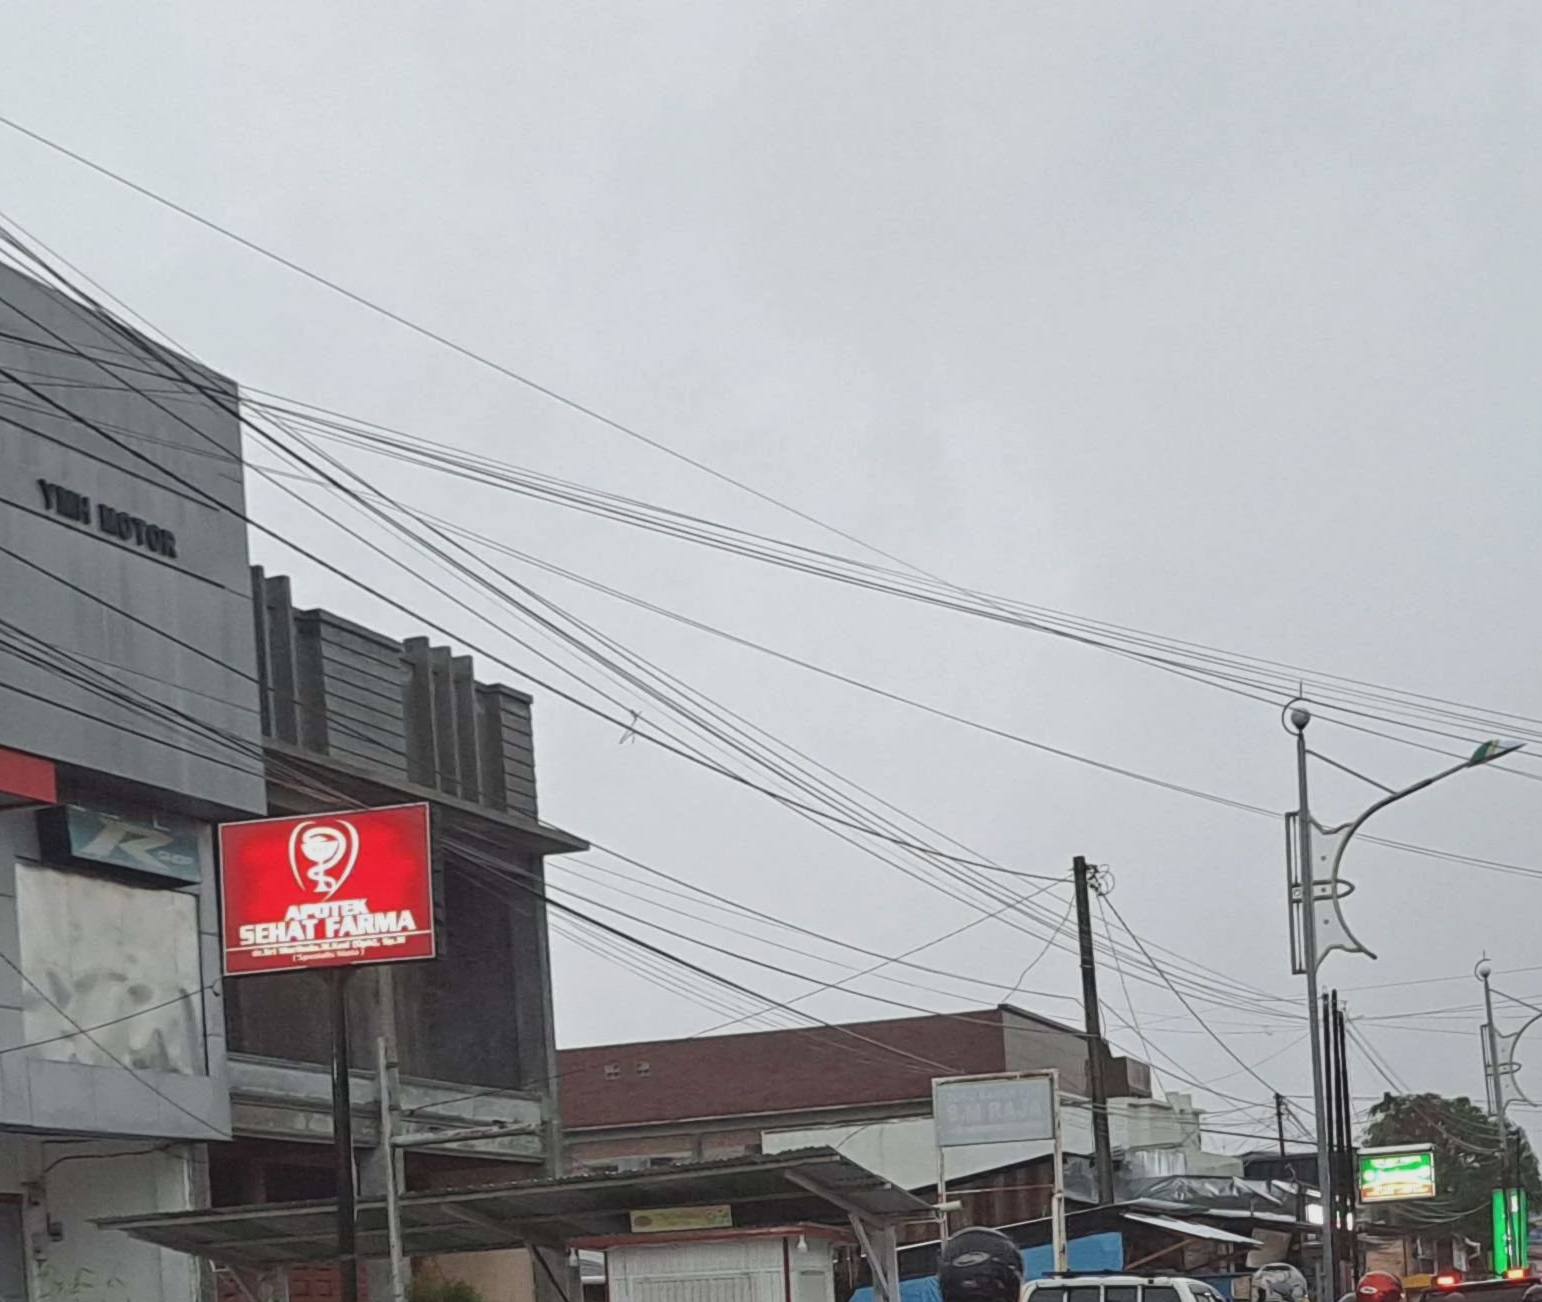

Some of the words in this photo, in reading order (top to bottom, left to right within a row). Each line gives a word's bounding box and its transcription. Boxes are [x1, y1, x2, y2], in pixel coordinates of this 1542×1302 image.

[97, 503, 177, 559] MOTOR
[239, 919, 319, 946] SEHAT
[325, 909, 417, 938] FARMA
[284, 898, 369, 923] APOTEK
